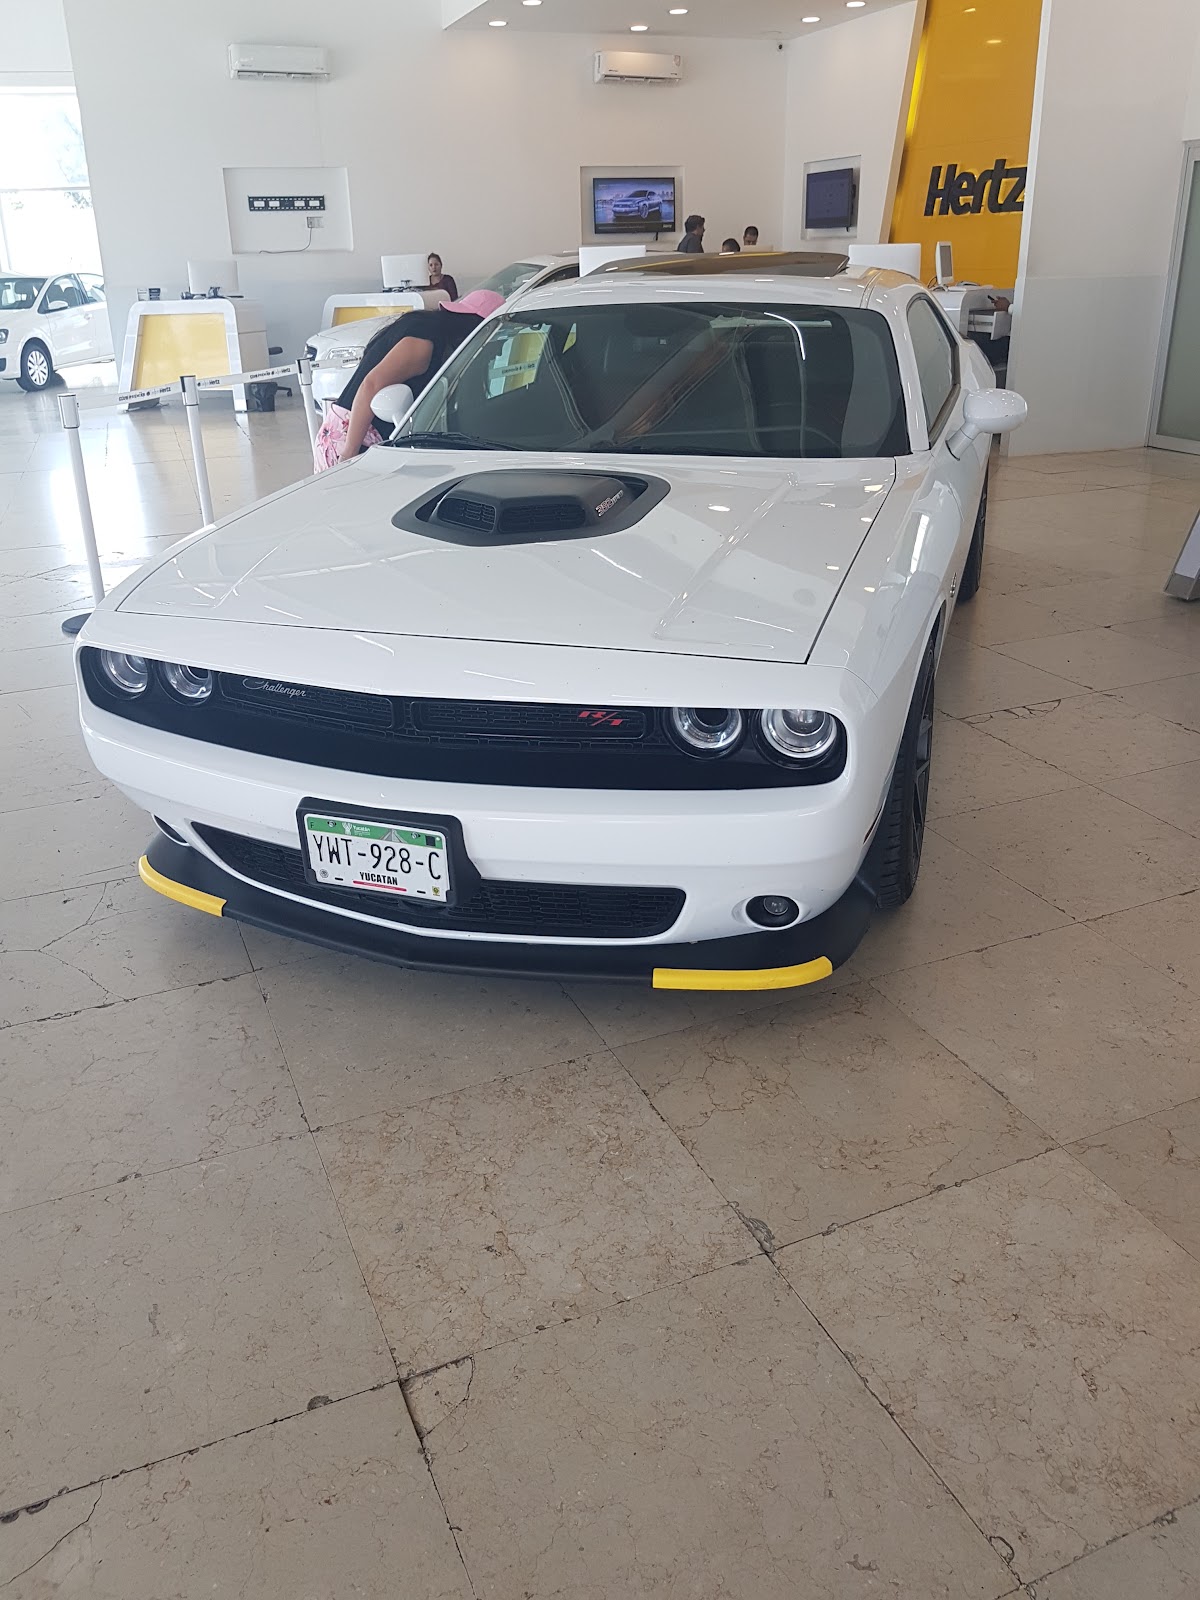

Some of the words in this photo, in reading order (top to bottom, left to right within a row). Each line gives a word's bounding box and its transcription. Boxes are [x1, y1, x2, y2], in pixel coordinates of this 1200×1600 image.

[924, 158, 1027, 216] Hertz
[242, 678, 307, 698] Challenger
[578, 710, 623, 726] R/T
[312, 834, 441, 880] YWT-928-C
[359, 871, 398, 886] YUCATAN
